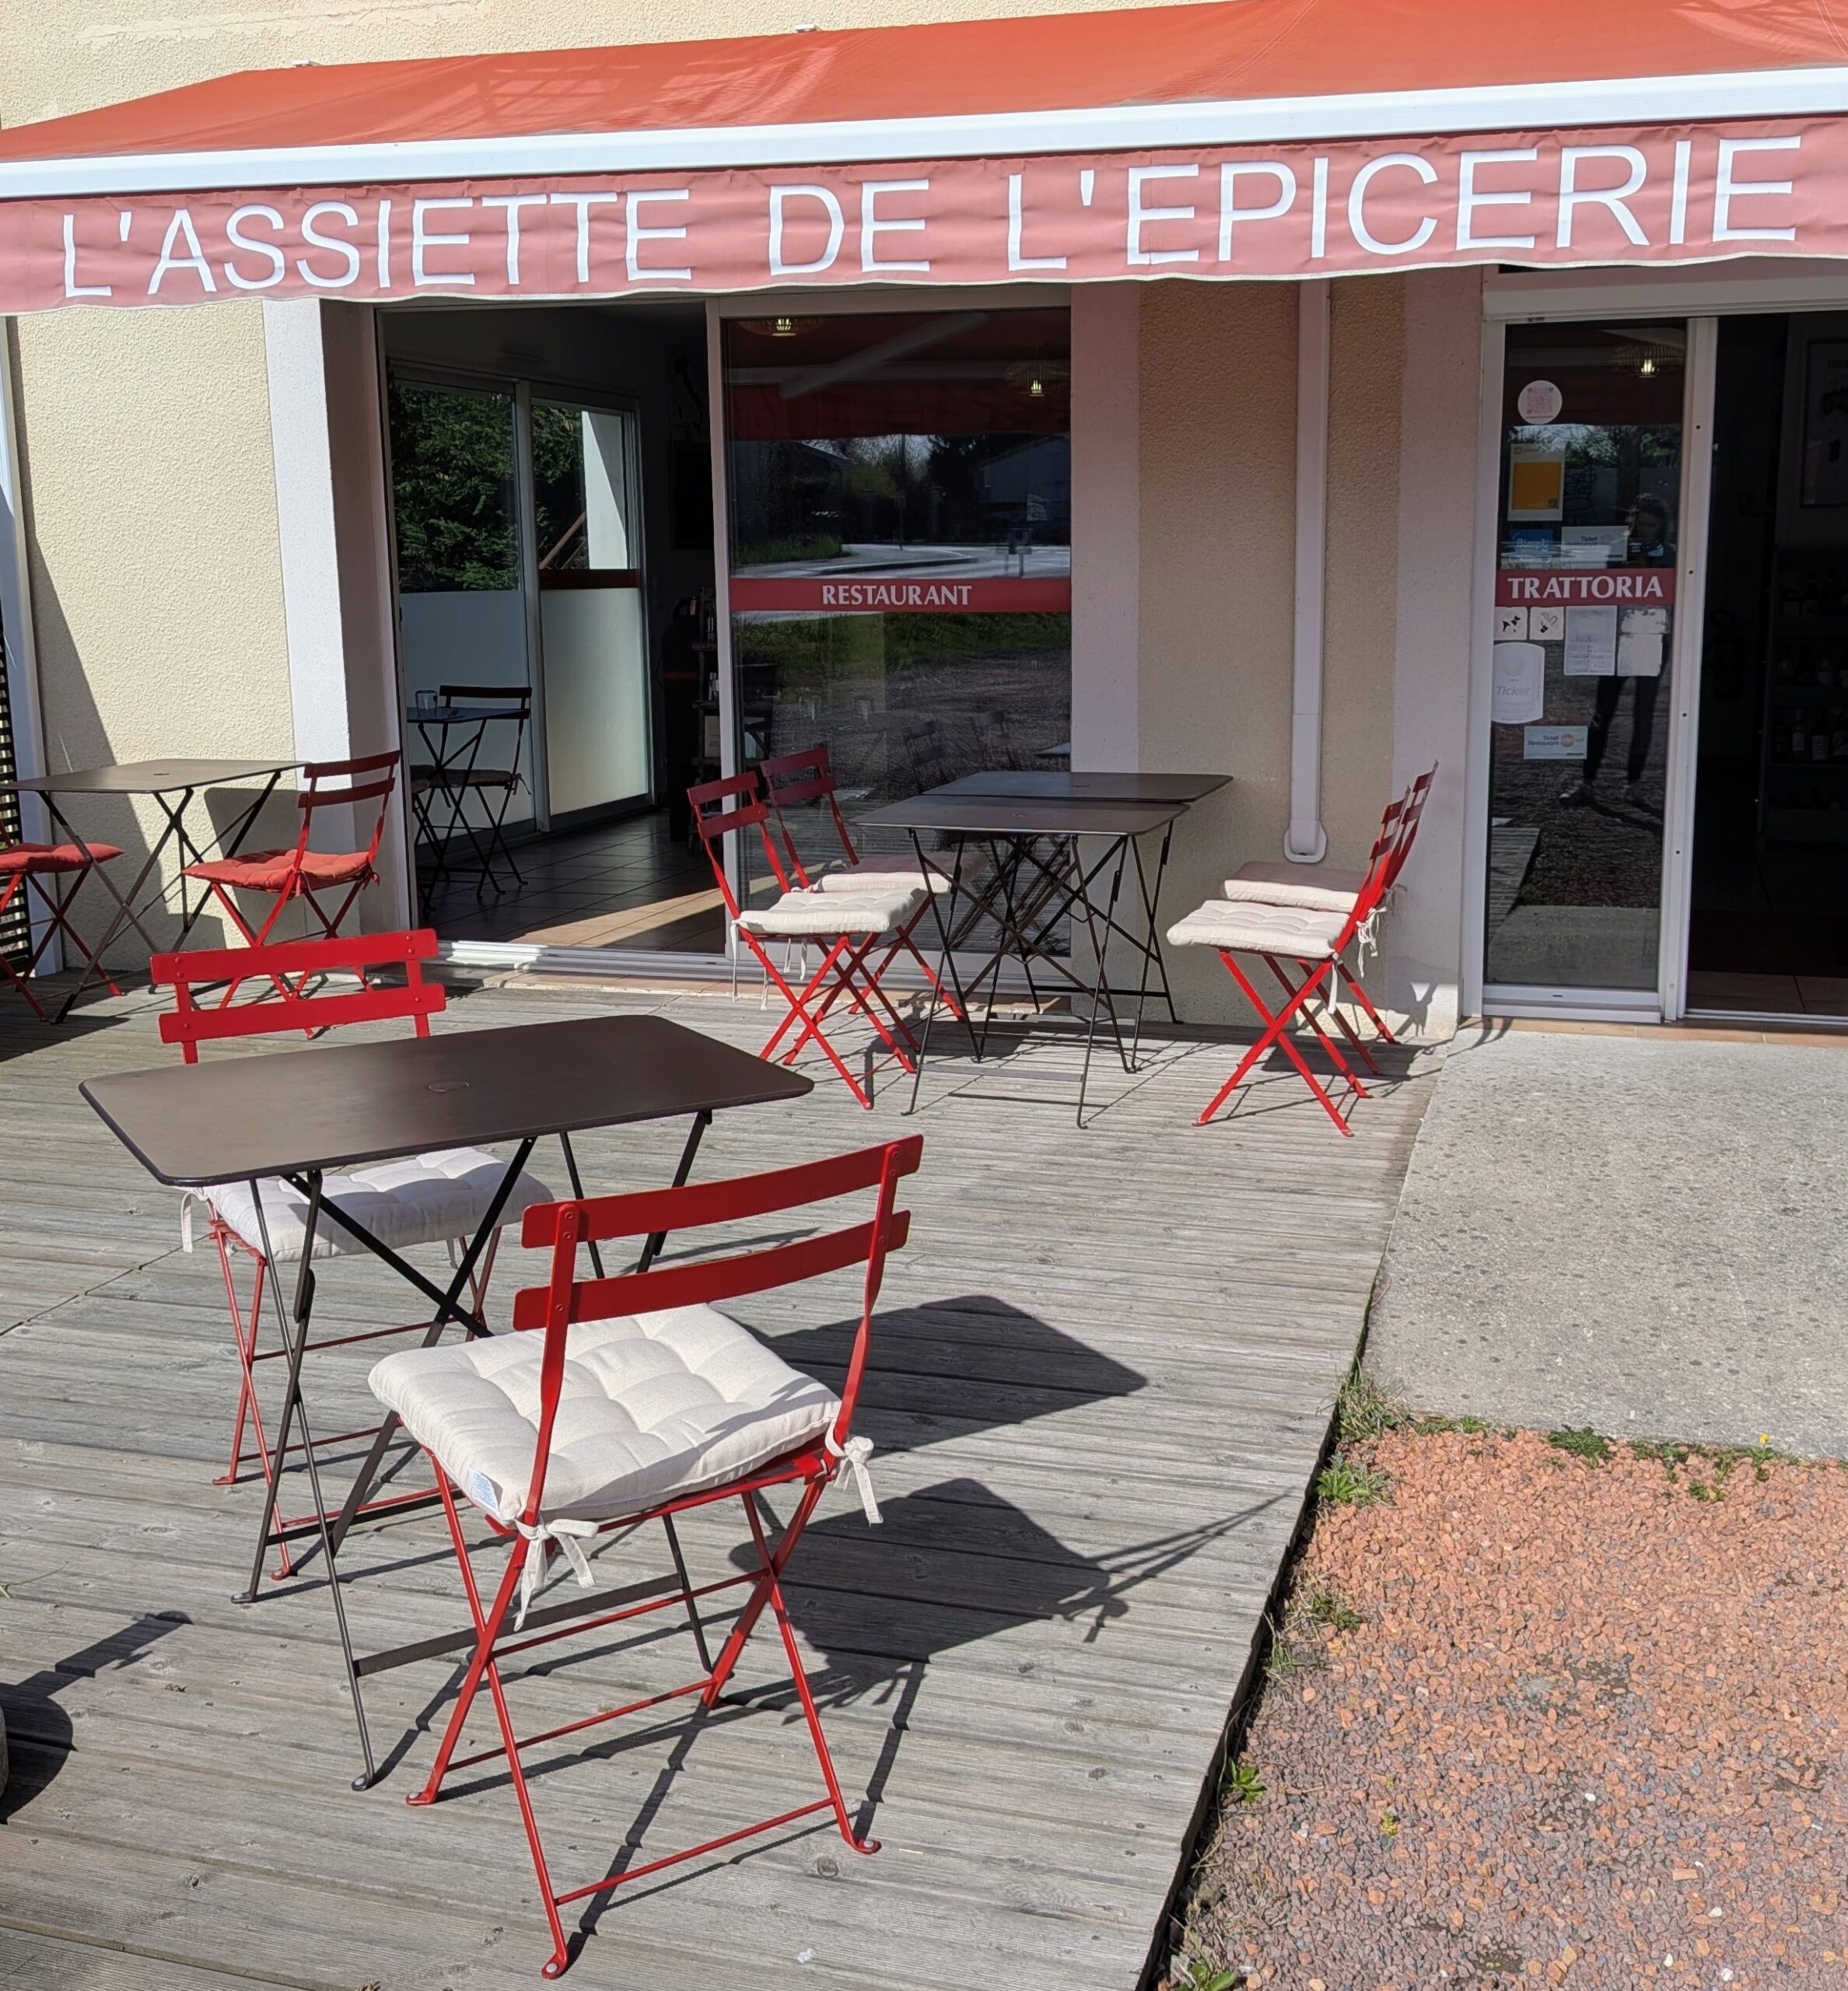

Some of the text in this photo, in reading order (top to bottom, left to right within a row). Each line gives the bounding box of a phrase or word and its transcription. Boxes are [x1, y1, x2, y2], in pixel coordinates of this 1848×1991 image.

[64, 135, 1801, 299] L'ASSIETTE DE L'EPICERIE
[822, 585, 972, 605] RESTAURANT
[1507, 576, 1664, 599] TRATTORIA
[1496, 685, 1531, 696] Ticket
